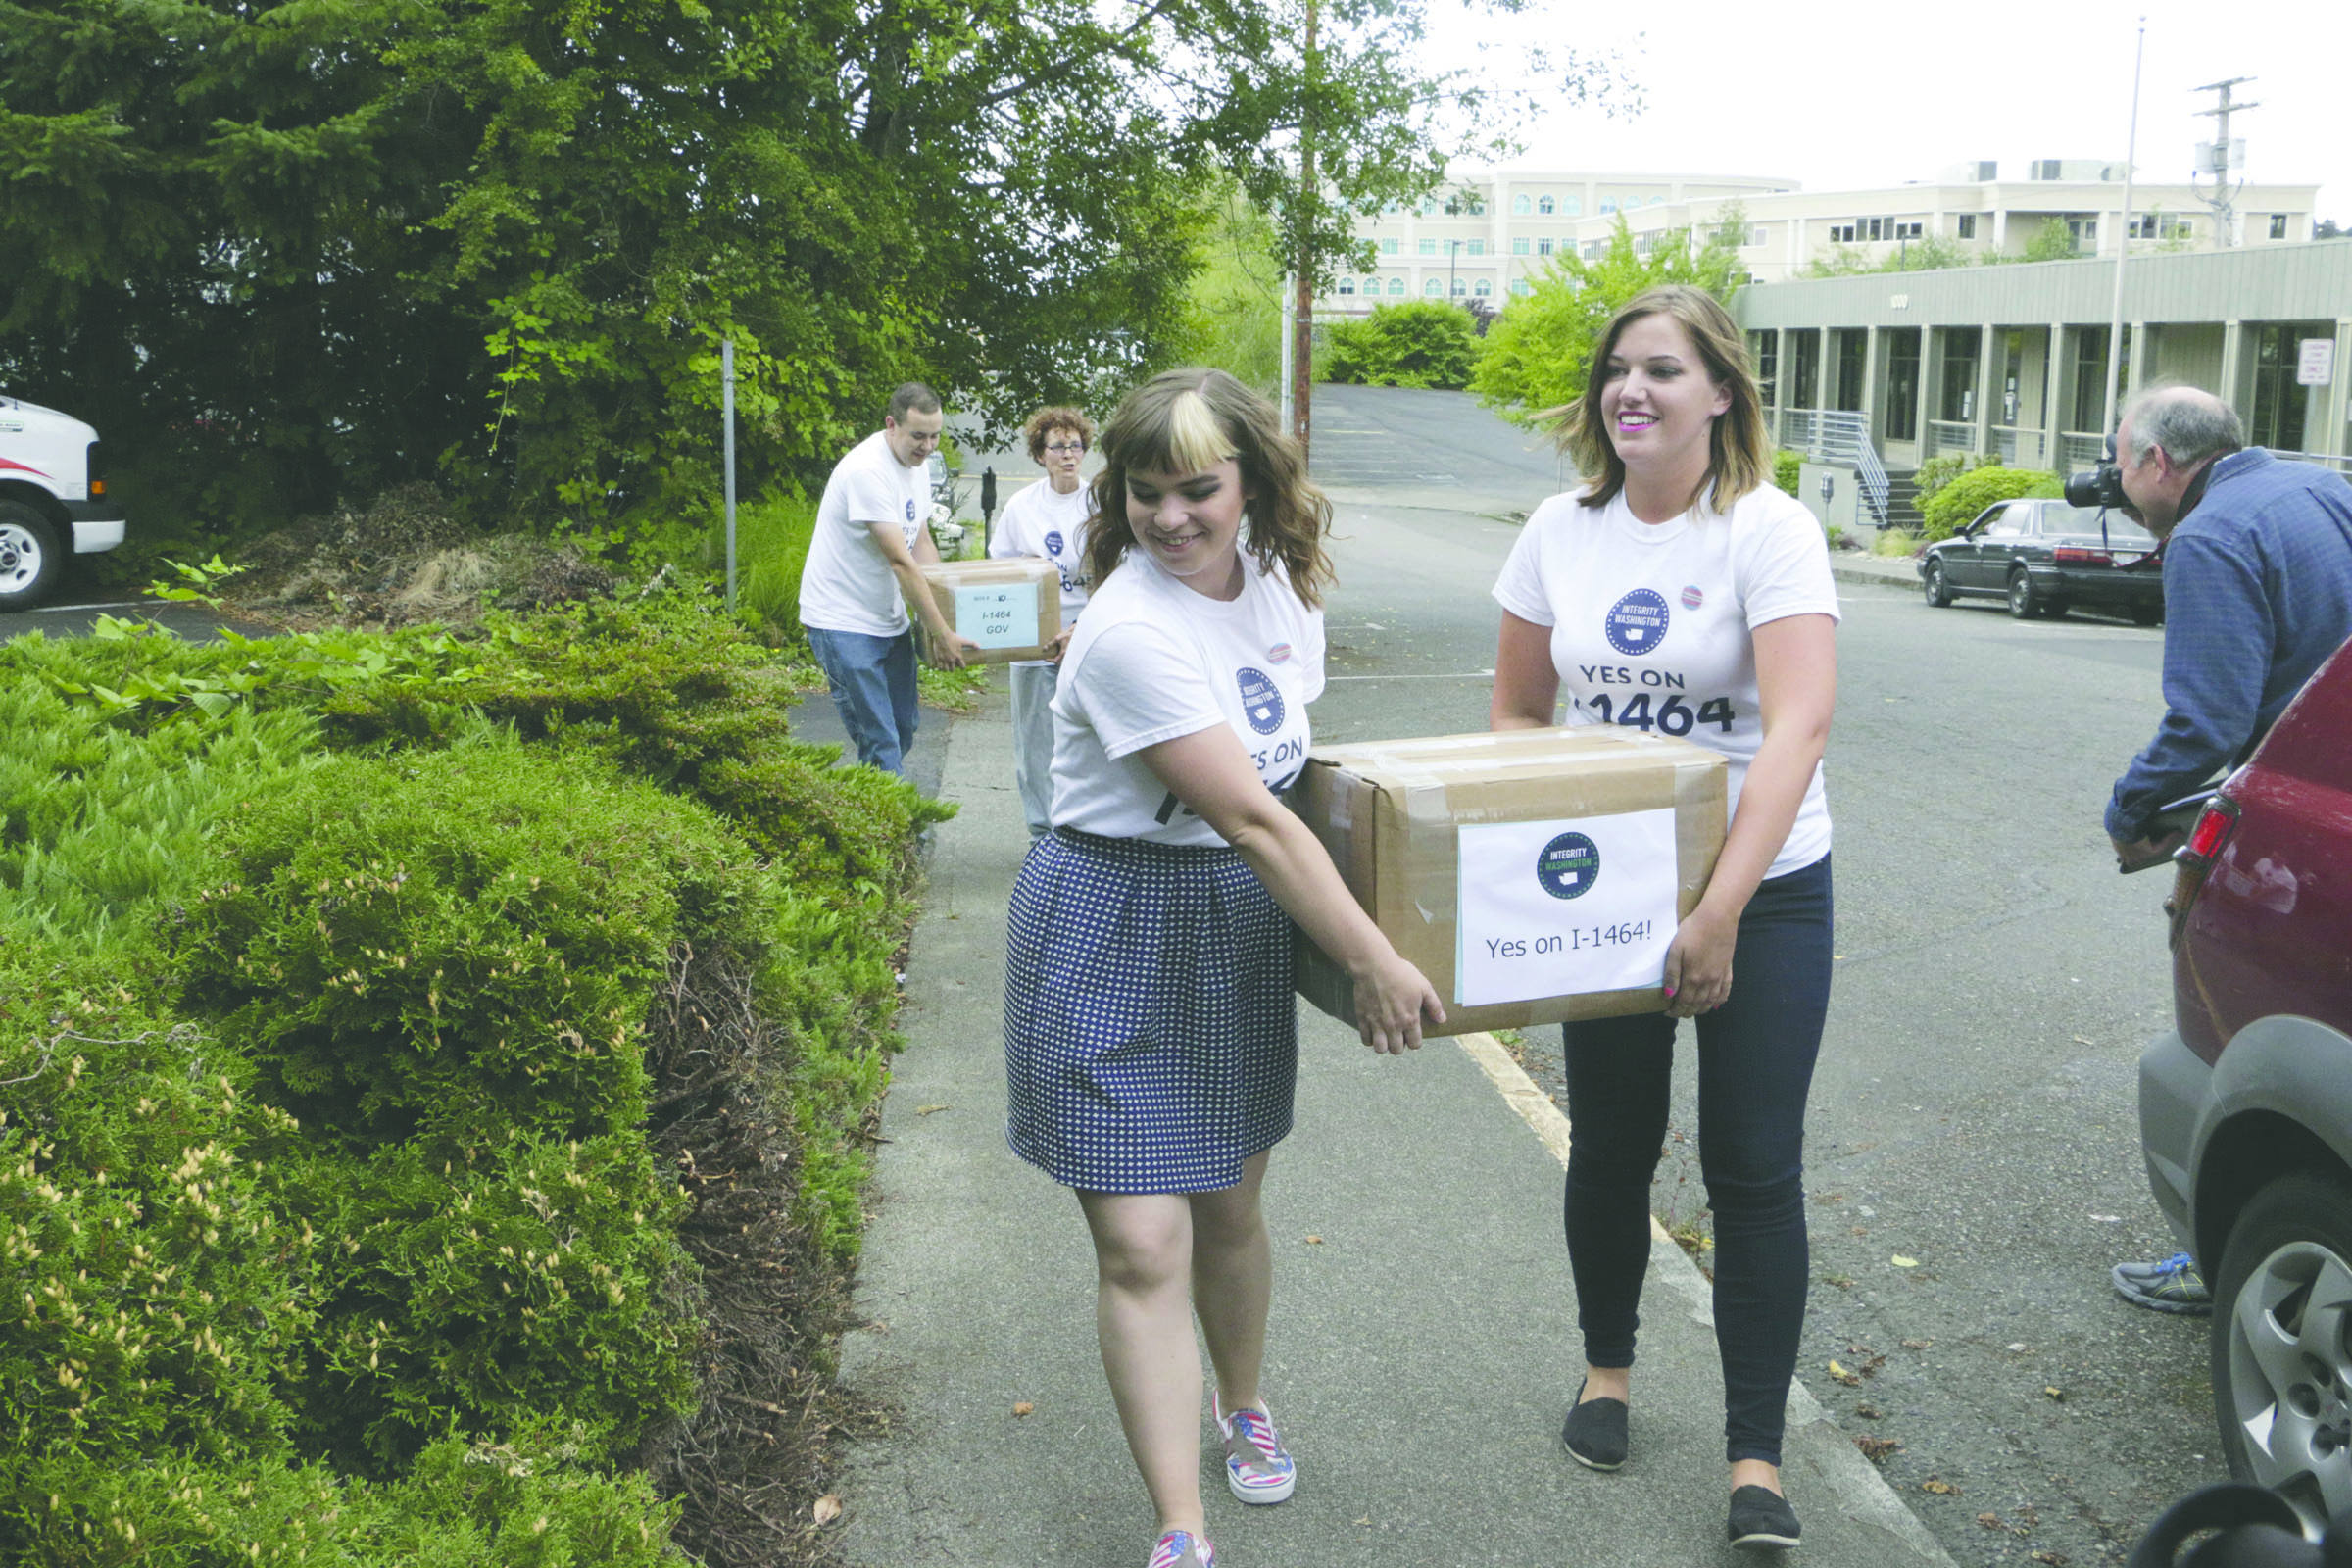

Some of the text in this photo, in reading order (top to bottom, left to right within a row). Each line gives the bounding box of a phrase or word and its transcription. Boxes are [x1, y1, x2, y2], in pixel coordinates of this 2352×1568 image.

[982, 611, 1011, 620] I-1464
[1621, 604, 1659, 617] INTEGRITY
[1614, 613, 1662, 628] WASHINGTON
[986, 625, 1009, 634] GOV
[1579, 664, 1685, 689] YES ON
[1574, 693, 1735, 736] 1464
[1274, 736, 1303, 763] ON
[1550, 847, 1588, 861] INTEGRITY
[1545, 857, 1592, 871] WASHINGTON
[1486, 919, 1652, 959] Yes on I-1464!
